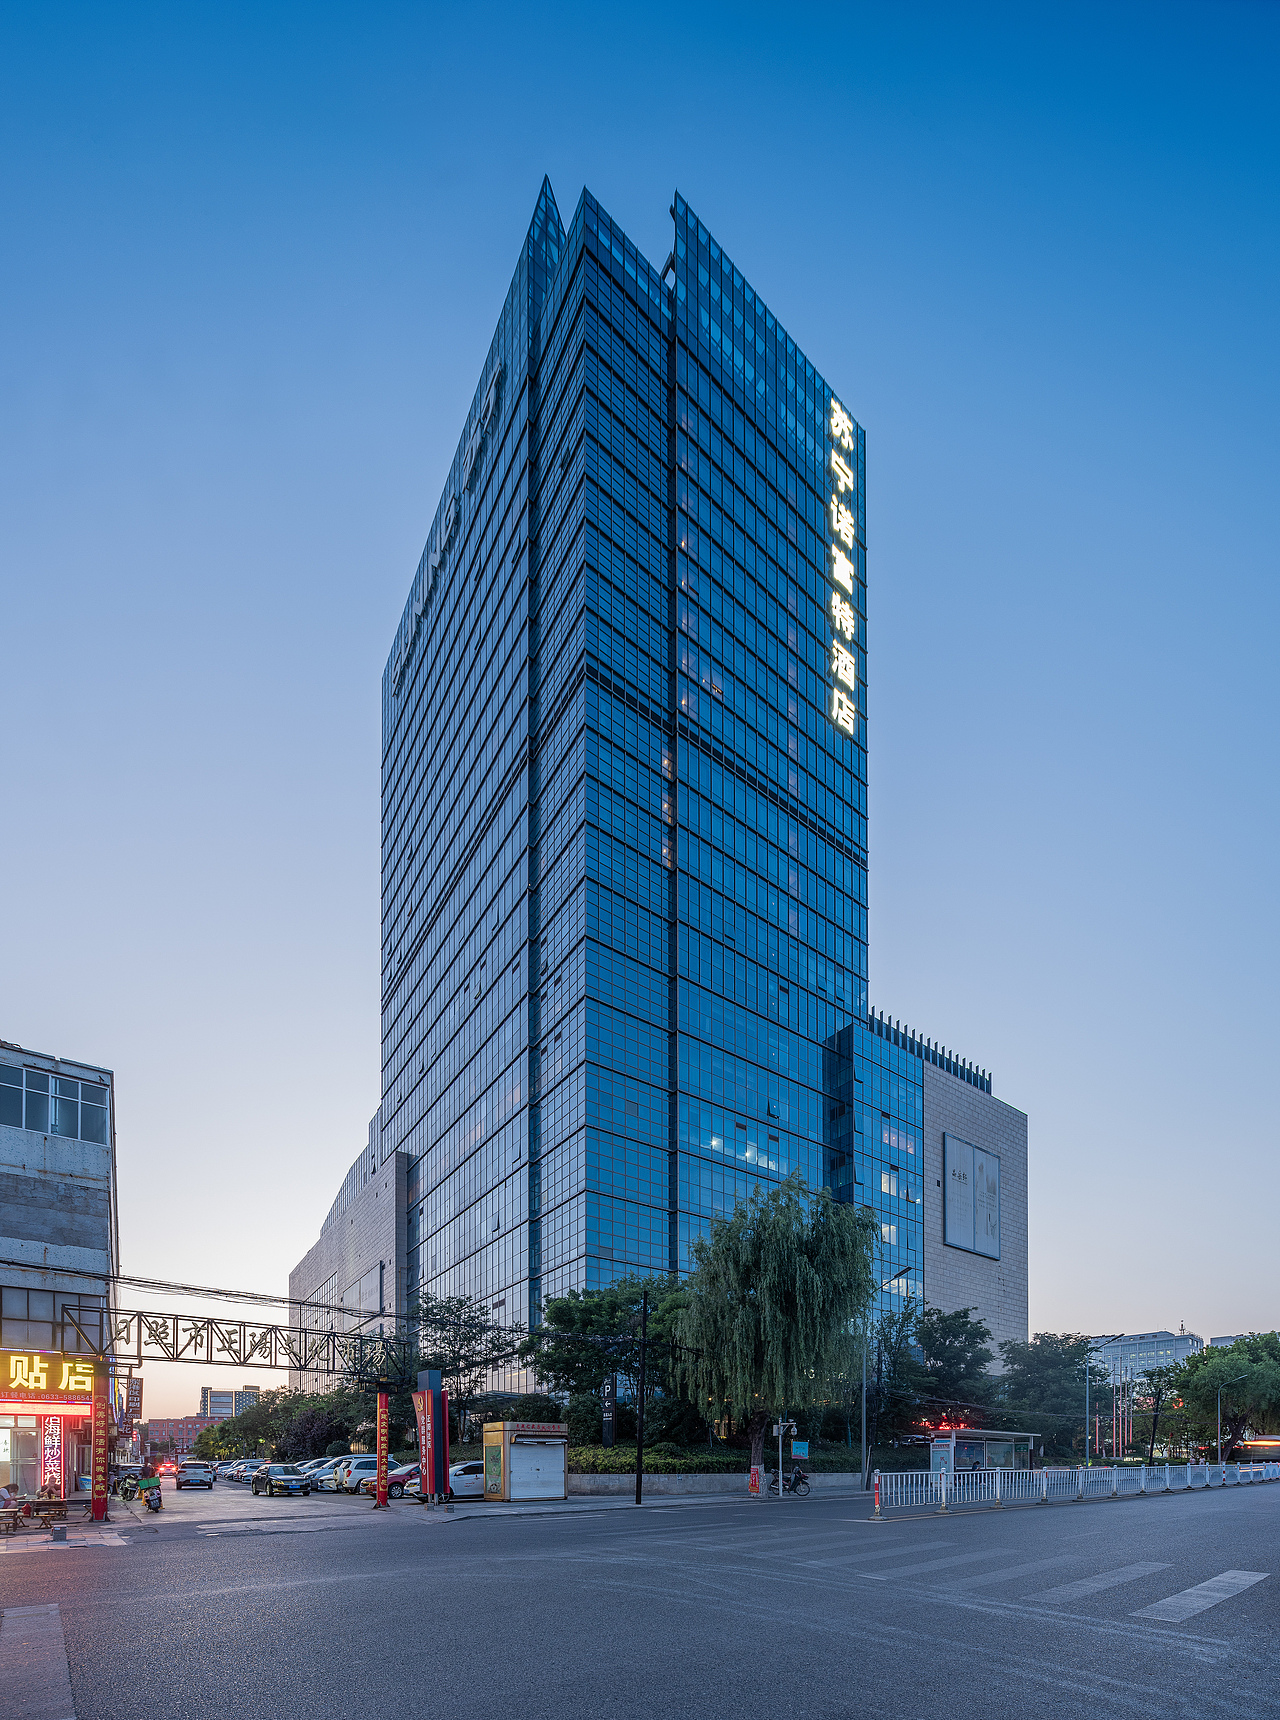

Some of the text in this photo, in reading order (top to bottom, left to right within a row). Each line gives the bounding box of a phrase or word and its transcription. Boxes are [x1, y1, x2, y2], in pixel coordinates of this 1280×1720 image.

[830, 397, 855, 736] 苏宁诺富特酒店
[8, 1355, 94, 1391] 贴店
